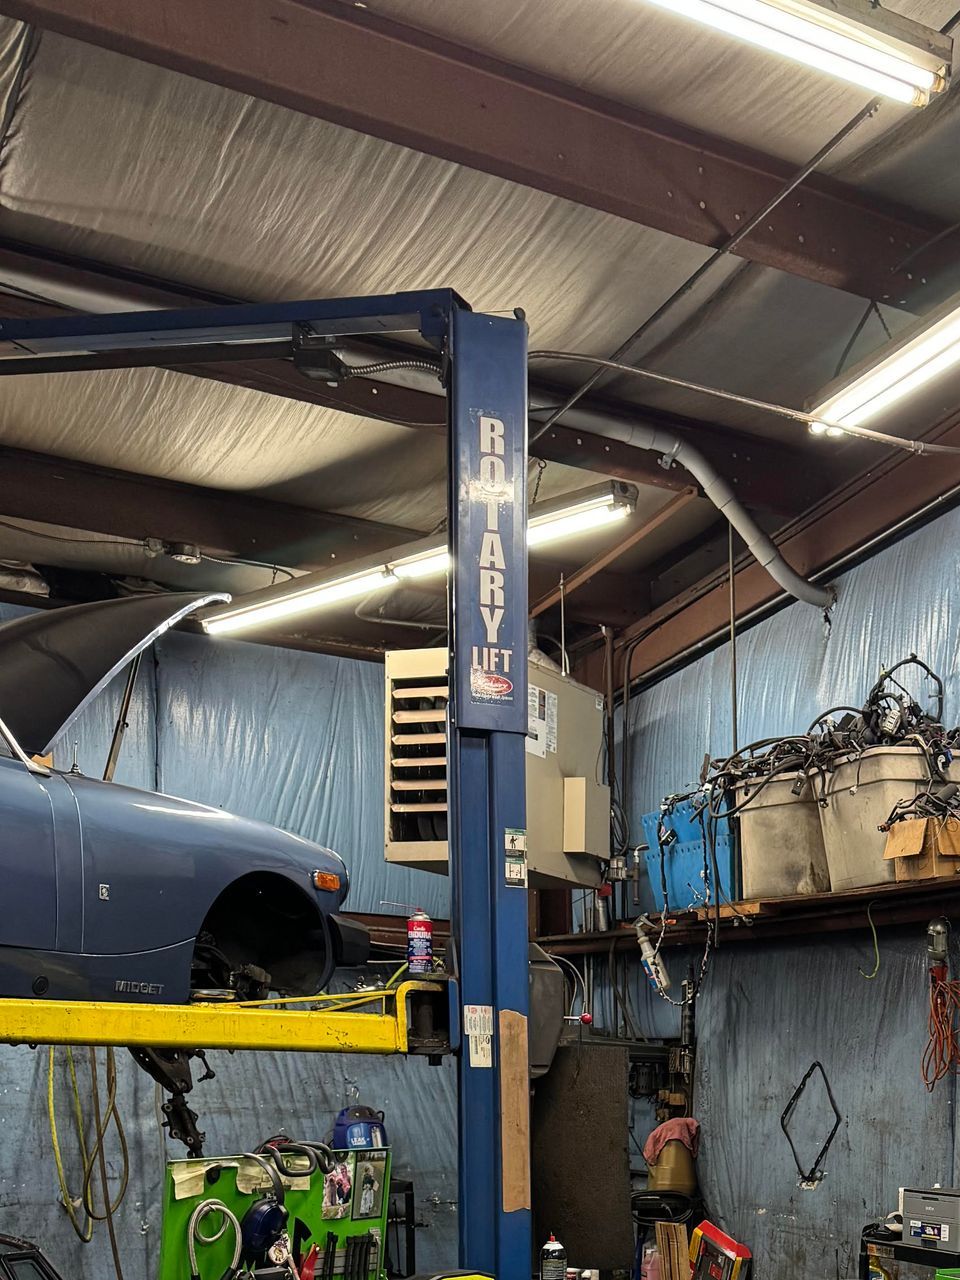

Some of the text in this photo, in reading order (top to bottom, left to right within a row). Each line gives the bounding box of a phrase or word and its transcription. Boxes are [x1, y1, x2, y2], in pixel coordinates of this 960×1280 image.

[480, 416, 506, 643] ROTARY
[472, 646, 513, 673] LIFT
[115, 980, 165, 995] MIDGET
